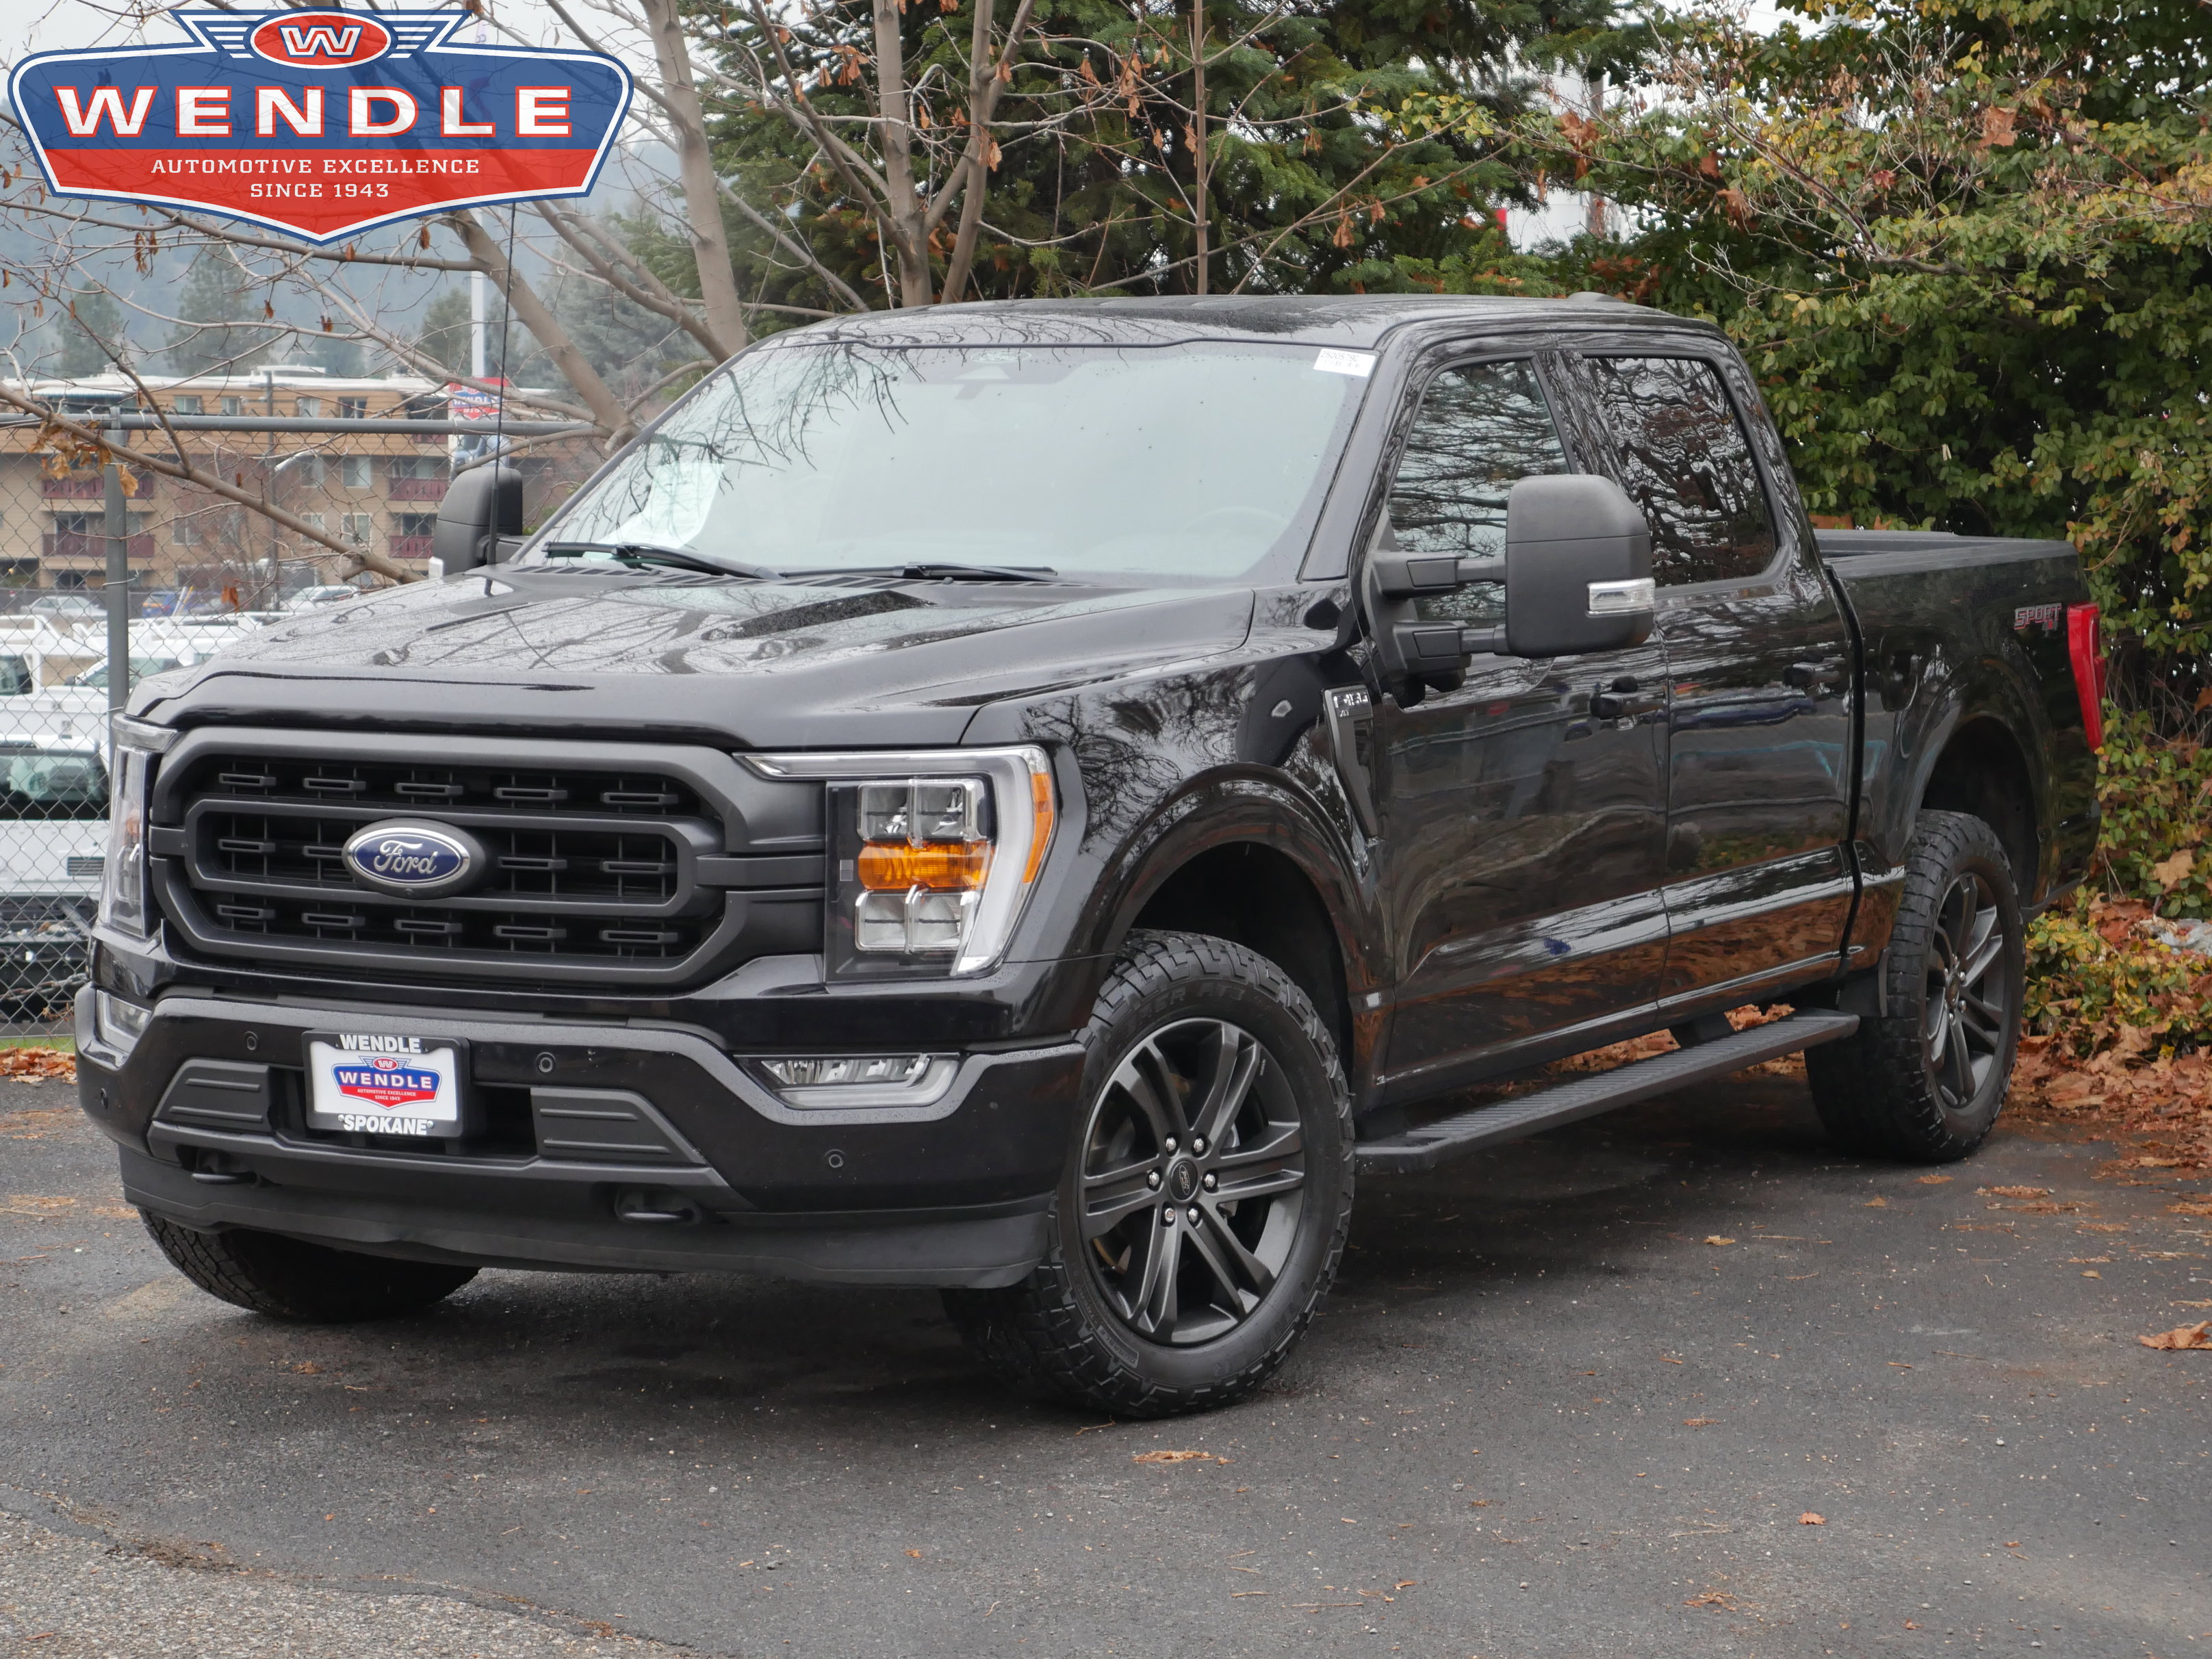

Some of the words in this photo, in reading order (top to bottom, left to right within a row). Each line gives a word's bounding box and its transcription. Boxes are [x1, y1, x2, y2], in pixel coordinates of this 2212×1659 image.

[2014, 602, 2062, 630] SPORT
[374, 840, 439, 875] Ford
[339, 1034, 422, 1053] WENDLE
[339, 1071, 432, 1089] WENDLE
[343, 1114, 427, 1135] SPOKANE
